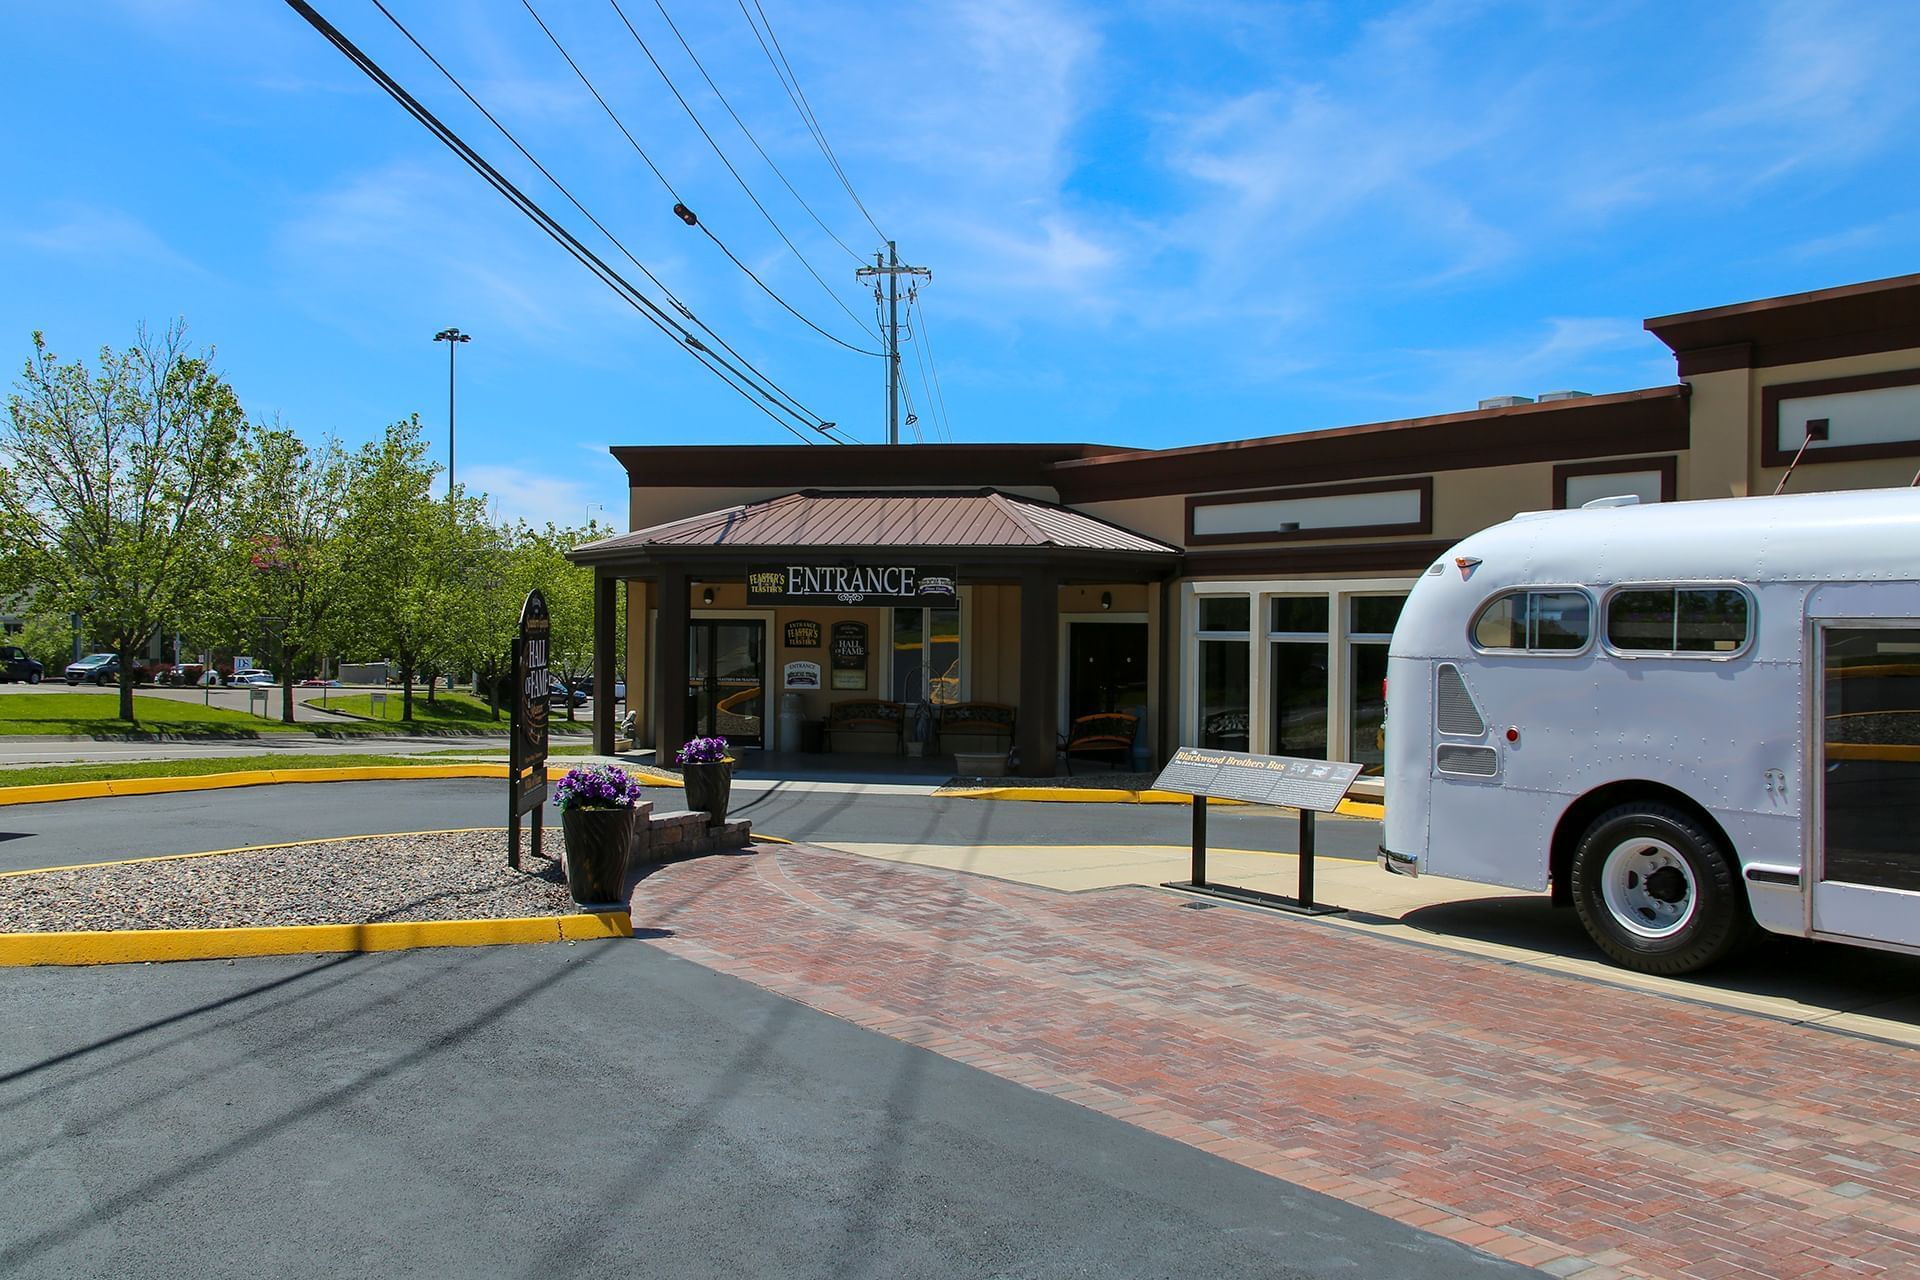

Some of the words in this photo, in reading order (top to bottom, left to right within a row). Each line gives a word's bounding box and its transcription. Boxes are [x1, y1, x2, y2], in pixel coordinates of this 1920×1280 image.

[786, 566, 915, 596] ENTRANCE
[528, 640, 547, 668] HALL
[841, 647, 864, 655] FAME
[525, 676, 531, 695] OF
[530, 668, 549, 699] FAME
[1175, 751, 1224, 765] Blackwood
[1225, 756, 1266, 769] Brothers
[1266, 760, 1286, 771] Bus
